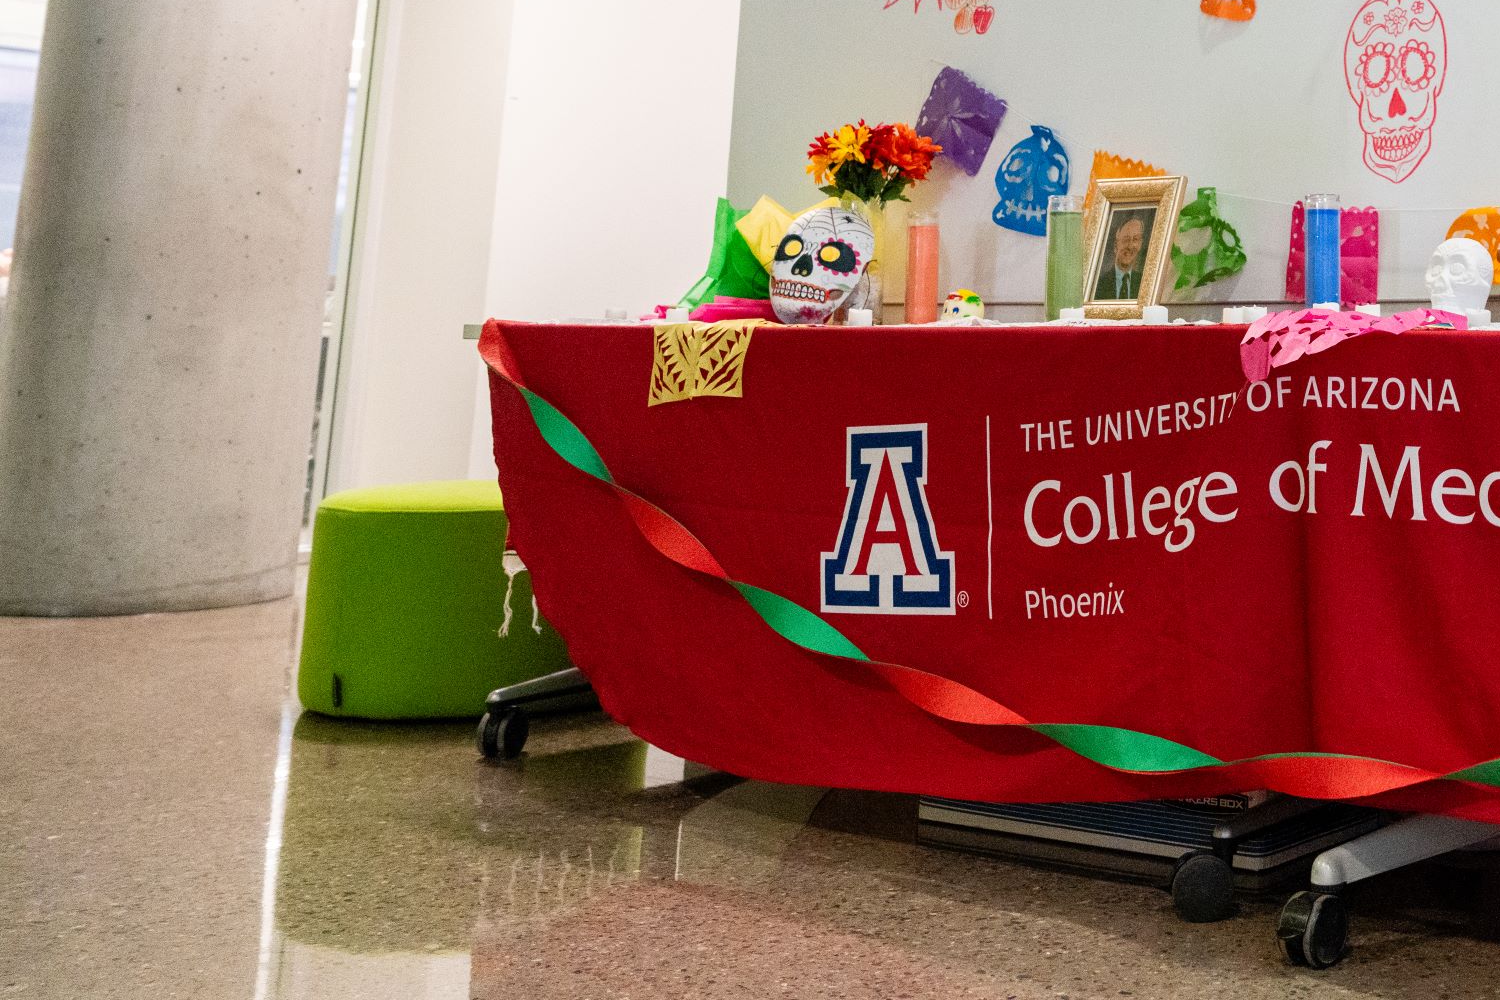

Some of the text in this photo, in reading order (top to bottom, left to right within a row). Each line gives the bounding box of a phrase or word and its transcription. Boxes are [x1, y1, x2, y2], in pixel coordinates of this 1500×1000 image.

[1020, 419, 1075, 453] THE
[1246, 376, 1293, 412] OF
[1302, 376, 1461, 413] ARIZONA
[819, 422, 957, 616] A
[1023, 470, 1239, 553] College
[1269, 439, 1333, 515] of
[1024, 582, 1125, 620] Phoenix
[1219, 798, 1244, 810] BOX
